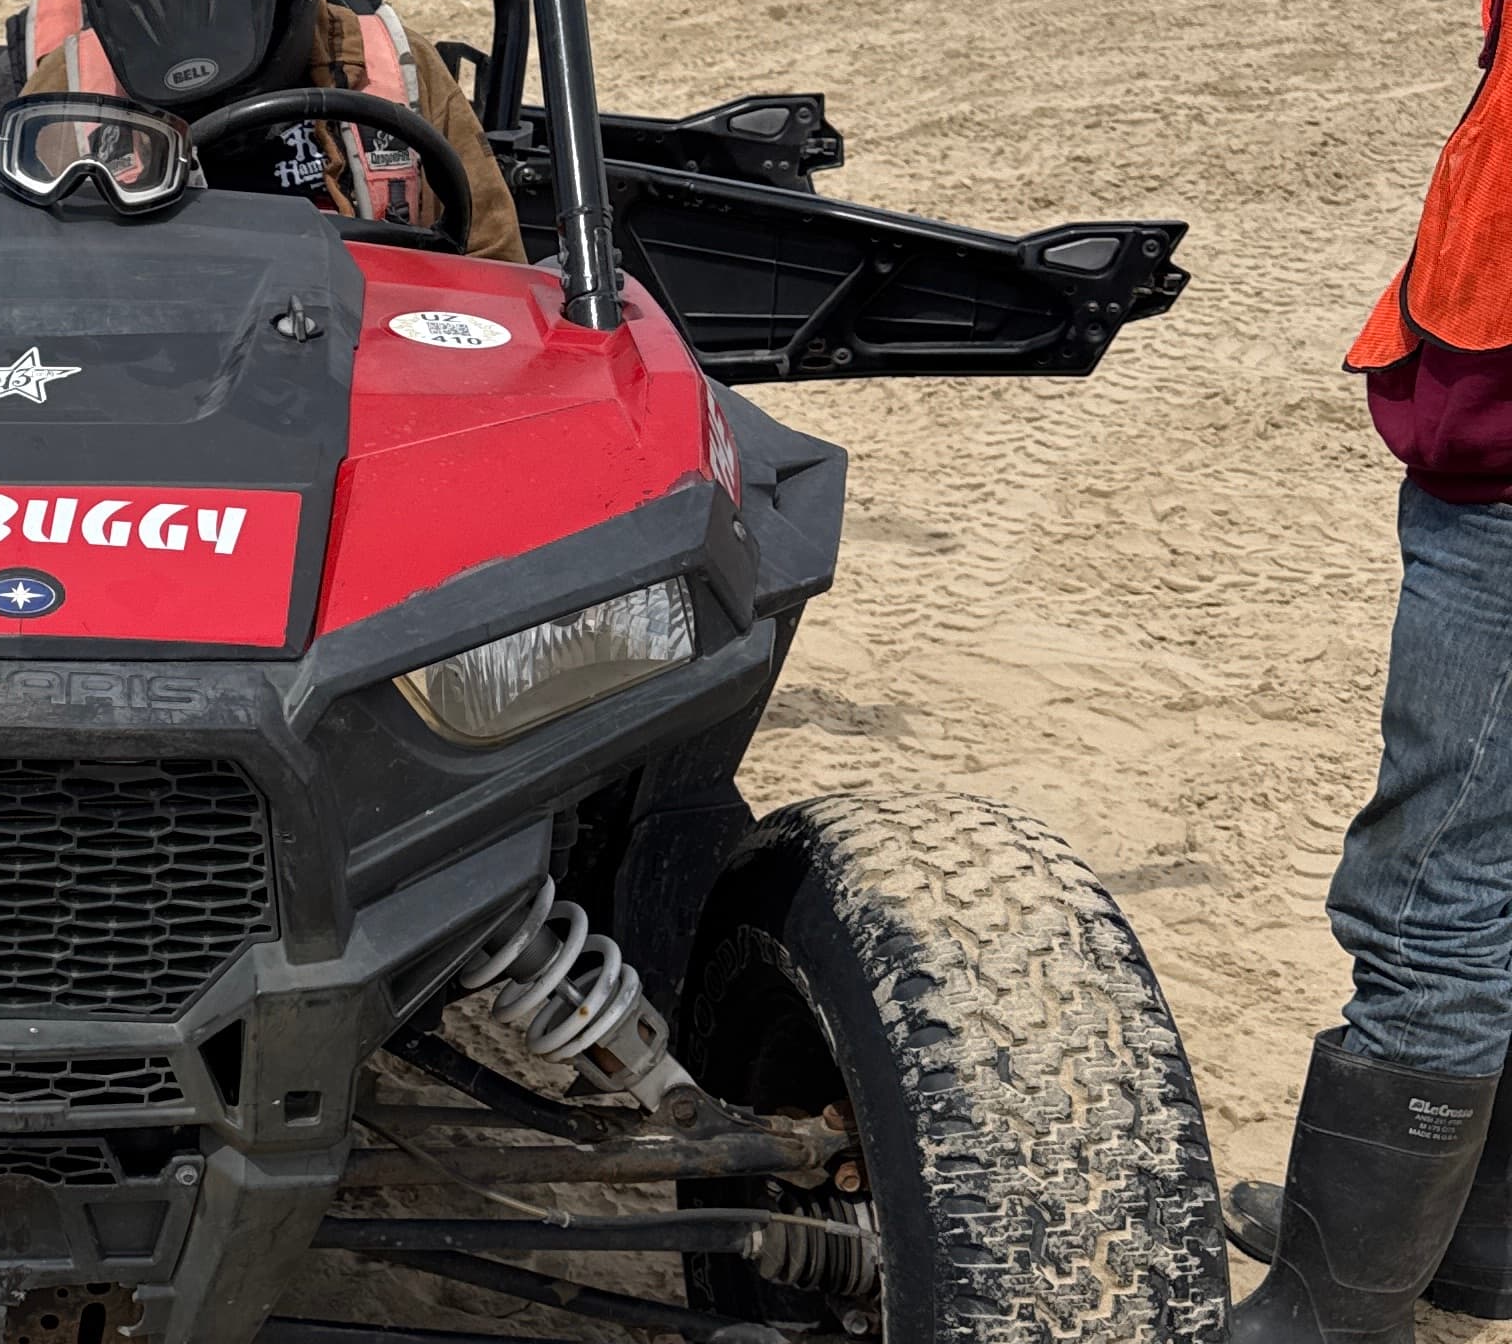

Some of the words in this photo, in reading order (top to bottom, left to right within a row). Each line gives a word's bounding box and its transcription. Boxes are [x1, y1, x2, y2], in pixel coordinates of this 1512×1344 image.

[172, 65, 210, 84] BELL
[420, 313, 461, 323] UZ
[431, 335, 482, 345] 410
